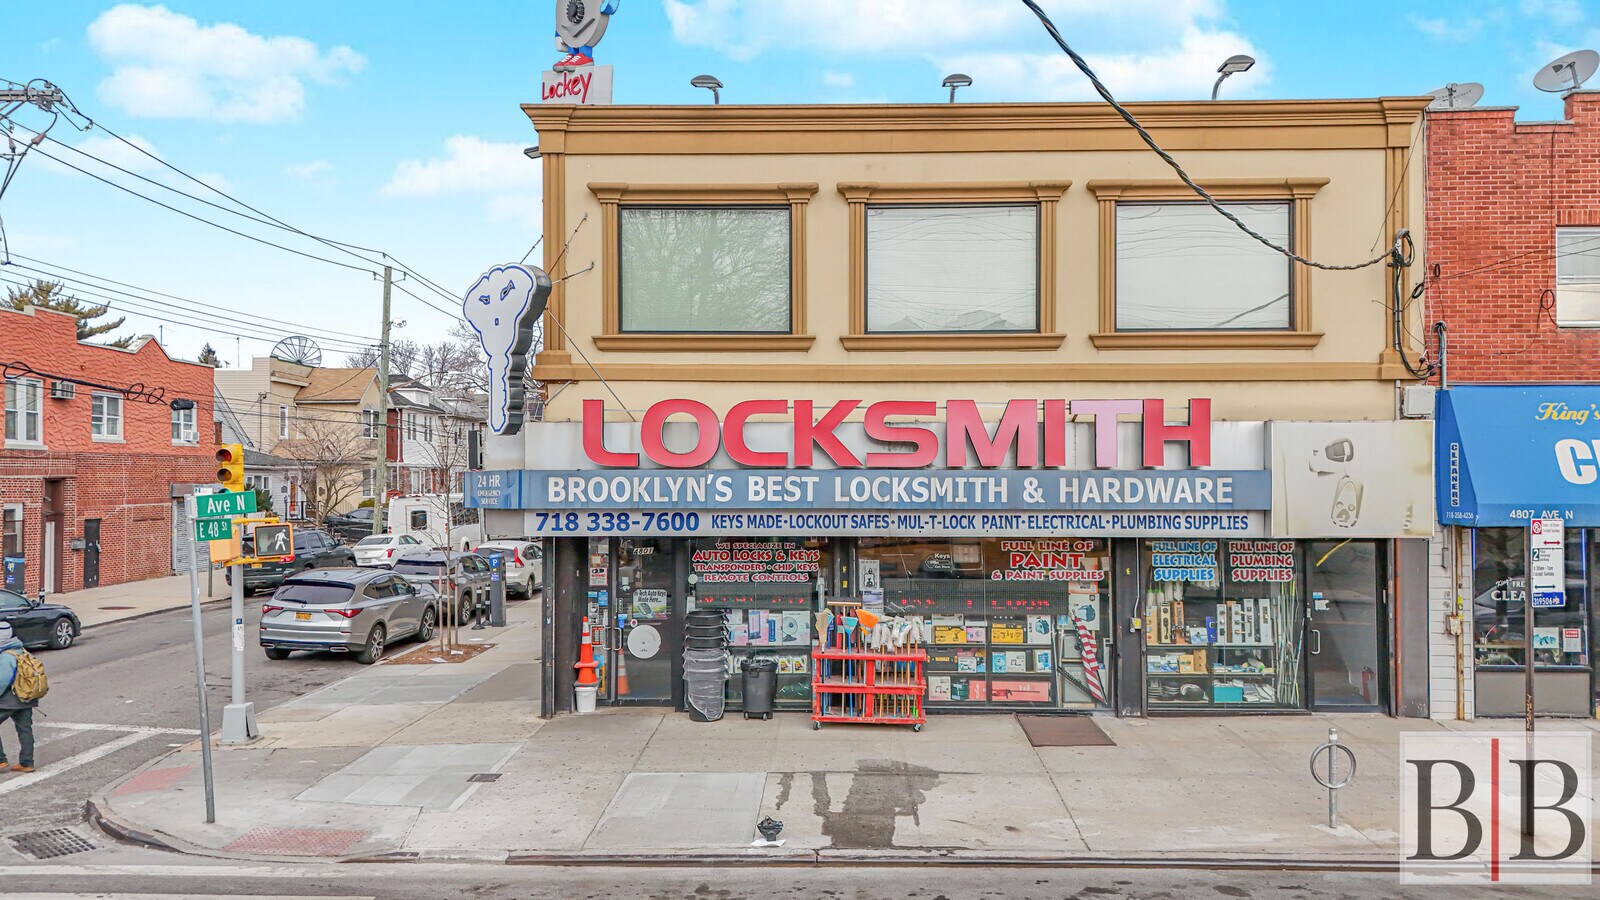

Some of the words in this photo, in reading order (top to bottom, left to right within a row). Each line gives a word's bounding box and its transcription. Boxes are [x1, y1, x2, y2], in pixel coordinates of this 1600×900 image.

[542, 72, 592, 104] Lockey
[582, 398, 1212, 469] LOCKSMITH
[477, 474, 487, 488] 24
[489, 474, 501, 488] HR
[1451, 443, 1459, 506] CLEANERS
[547, 474, 733, 503] BROOKLYN'S
[748, 476, 820, 503] BEST
[835, 476, 1008, 503] LOCKSMITH
[1022, 476, 1046, 504] &
[1059, 476, 1233, 504] HARDWARE
[207, 497, 230, 514] Ave
[236, 494, 245, 511] N
[1509, 509, 1535, 519] 4807
[1565, 509, 1574, 520] N
[535, 512, 579, 532] 718
[586, 512, 700, 532] 338-7600
[711, 514, 743, 530] KEYS
[747, 514, 782, 530] MADE
[789, 514, 848, 530] LOCKOUT
[851, 514, 889, 530] SAFES
[898, 514, 975, 530] MUL-T-LOCK
[982, 515, 1021, 530] PAINT
[1028, 515, 1106, 530] ELECTRICAL
[1112, 515, 1181, 530] PLUMBING
[1184, 515, 1249, 531] SUPPLIES
[199, 522, 205, 538] E
[207, 521, 219, 538] 48
[221, 521, 228, 531] St
[716, 542, 730, 550] WE
[733, 542, 782, 550] SPECIALIZE
[784, 542, 795, 550] IN
[1002, 541, 1034, 551] FULL
[1038, 541, 1069, 551] LINE
[1073, 541, 1093, 551] OF
[1152, 541, 1177, 552] FULL
[1178, 541, 1200, 552] LINE
[1202, 541, 1217, 552] OF
[1229, 541, 1253, 552] FULL
[1254, 541, 1276, 552] LINE
[1278, 541, 1294, 552] OF
[692, 550, 731, 561] AUTO
[733, 550, 772, 561] LOCKS
[775, 550, 786, 561] &
[789, 550, 820, 561] KEYS
[1010, 552, 1084, 569] PAINT
[1152, 553, 1217, 567] ELECTRICAL
[1230, 554, 1294, 567] PLUMBING
[1533, 549, 1539, 561] 2
[492, 559, 498, 567] P
[693, 563, 766, 572] TRANSPONDERS
[772, 563, 793, 572] CHIP
[796, 563, 819, 572] KEYS
[703, 573, 749, 582] REMOTE
[752, 573, 809, 582] CONTROLS
[991, 570, 1002, 580] &
[1005, 570, 1044, 580] PAINT
[1049, 570, 1104, 580] SUPPLIES
[1154, 568, 1214, 581] SUPPLIES
[1231, 569, 1293, 581] SUPPLIES
